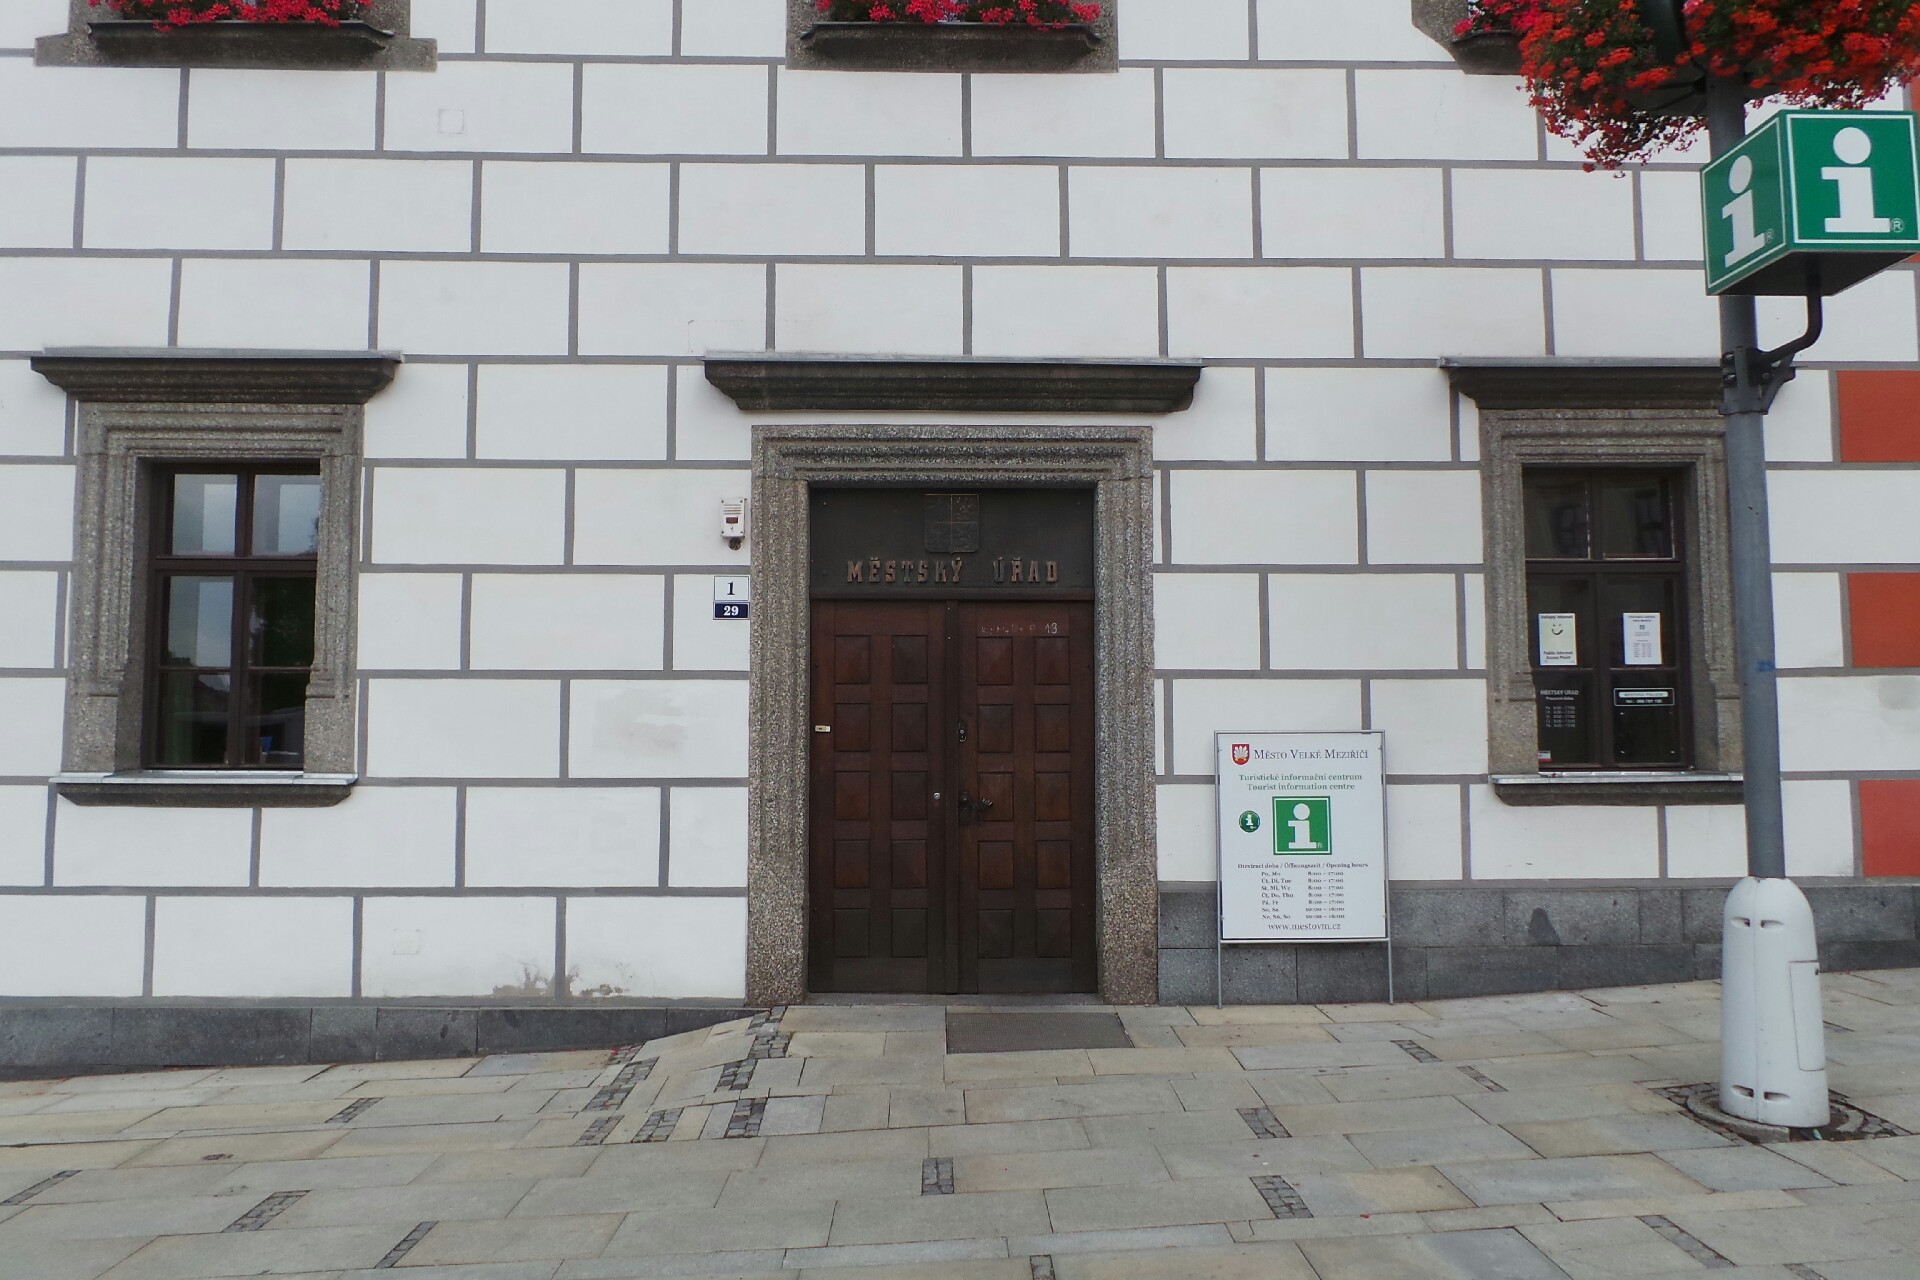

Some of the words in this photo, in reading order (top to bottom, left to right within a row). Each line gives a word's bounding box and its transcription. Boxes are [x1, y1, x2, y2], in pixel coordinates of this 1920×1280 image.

[847, 557, 963, 583] MĚSTSKÝ
[992, 557, 1058, 583] ÚŘAD
[726, 581, 736, 596] 1
[723, 605, 739, 616] 29
[1254, 749, 1288, 759] MĚSTO
[1290, 749, 1321, 759] VELKÉ
[1278, 783, 1328, 791] information
